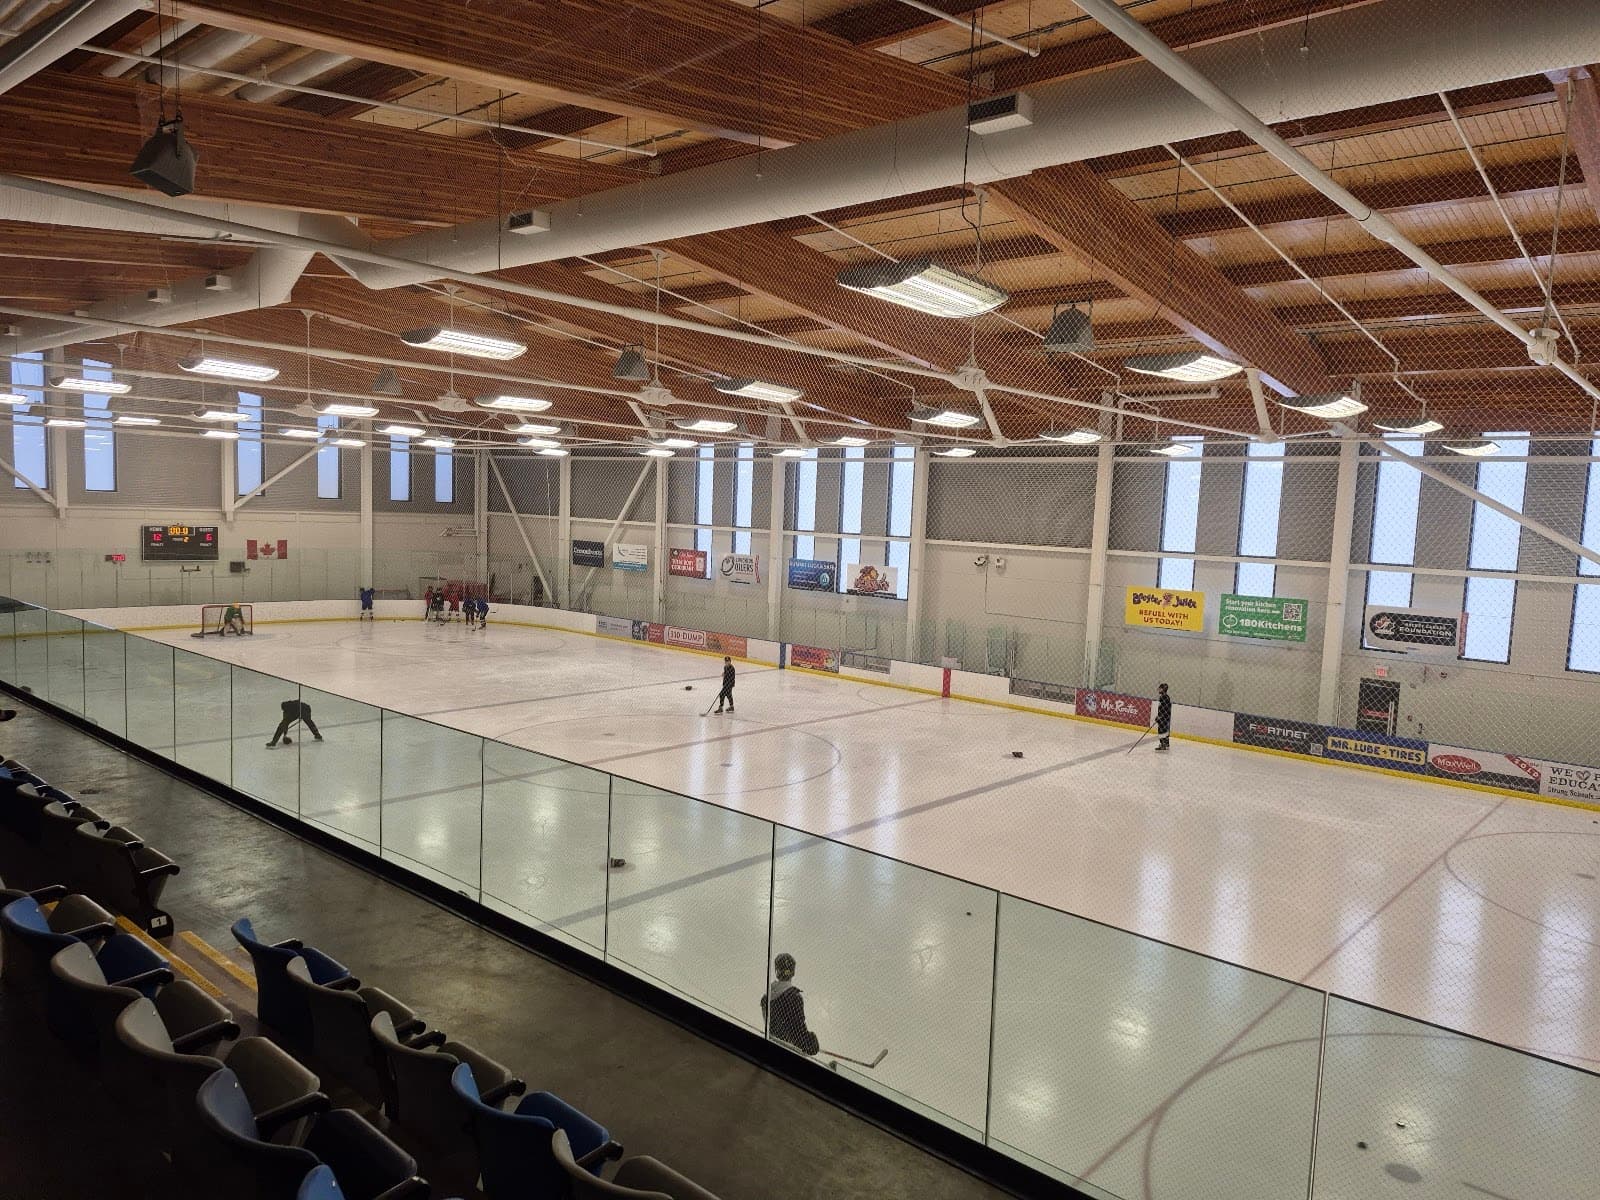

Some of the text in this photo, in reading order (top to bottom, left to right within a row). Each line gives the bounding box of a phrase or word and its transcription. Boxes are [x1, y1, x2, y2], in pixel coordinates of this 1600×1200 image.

[1139, 609, 1189, 620] REFUEL WITH
[1143, 616, 1183, 627] US TODAY!
[1239, 618, 1303, 632] 180Kitchens
[1399, 626, 1452, 637] FOUNDATION
[1249, 723, 1310, 739] FORTINET
[1330, 738, 1352, 750] MR.
[1354, 742, 1380, 755] LUBE
[1389, 748, 1422, 762] TIRES
[1437, 758, 1477, 770] MaxWell
[1550, 766, 1573, 777] WE
[1549, 776, 1600, 791] EDUCA
